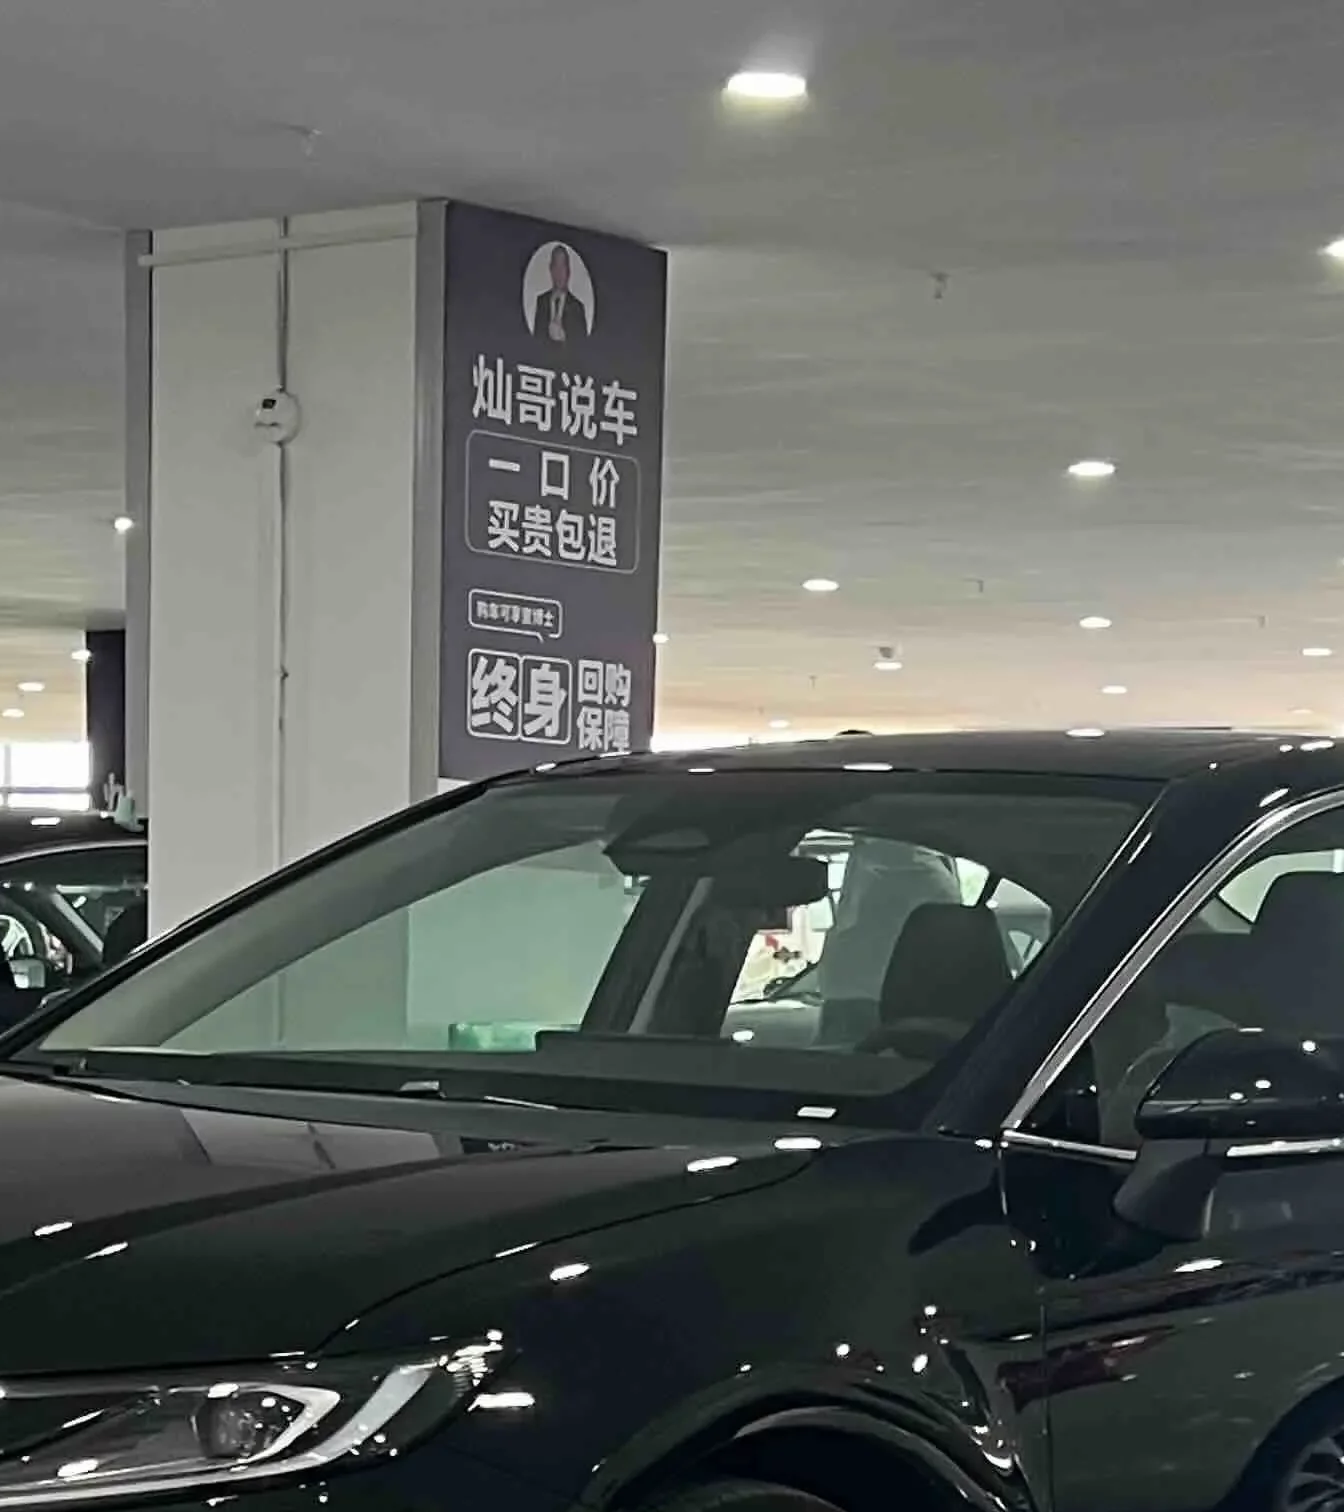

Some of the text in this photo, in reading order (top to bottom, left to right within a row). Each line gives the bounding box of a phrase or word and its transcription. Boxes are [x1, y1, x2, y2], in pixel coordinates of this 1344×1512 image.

[472, 354, 638, 446] 灿哥说车
[488, 450, 620, 508] 一口价
[487, 500, 618, 567] 买贵包退
[471, 656, 568, 738] 终身
[576, 659, 633, 707] 回购
[576, 706, 631, 753] 保障
